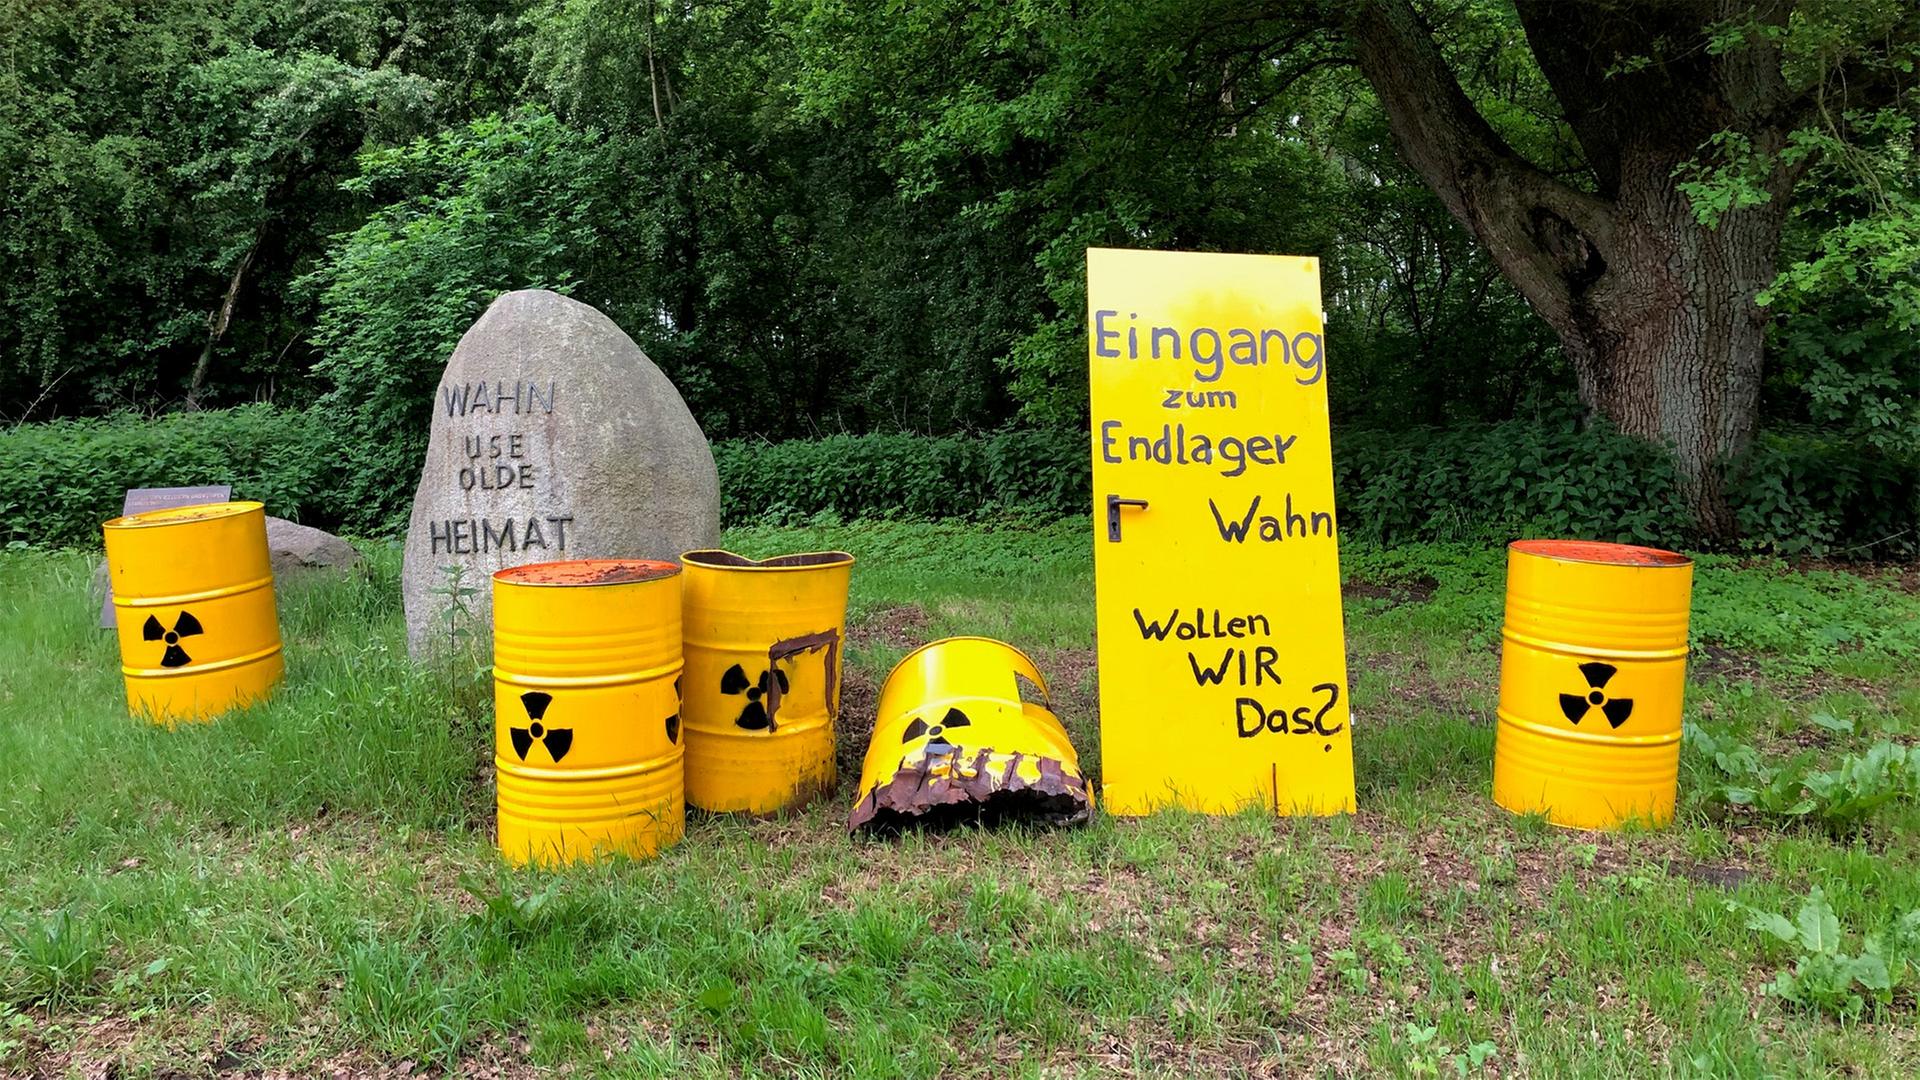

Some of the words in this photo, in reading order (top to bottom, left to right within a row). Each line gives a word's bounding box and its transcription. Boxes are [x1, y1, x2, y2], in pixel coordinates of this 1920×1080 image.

[1095, 310, 1324, 386] Eingang
[443, 380, 555, 417] WAHN
[1161, 390, 1237, 409] zum
[465, 433, 524, 459] USE
[1101, 420, 1298, 478] Endlager
[459, 463, 536, 491] OLDE
[430, 515, 574, 555] HEIMAT
[1208, 493, 1334, 544] Wahn
[1133, 607, 1271, 642] Wollen
[1188, 646, 1282, 687] WIR
[1235, 682, 1344, 753] Das?
